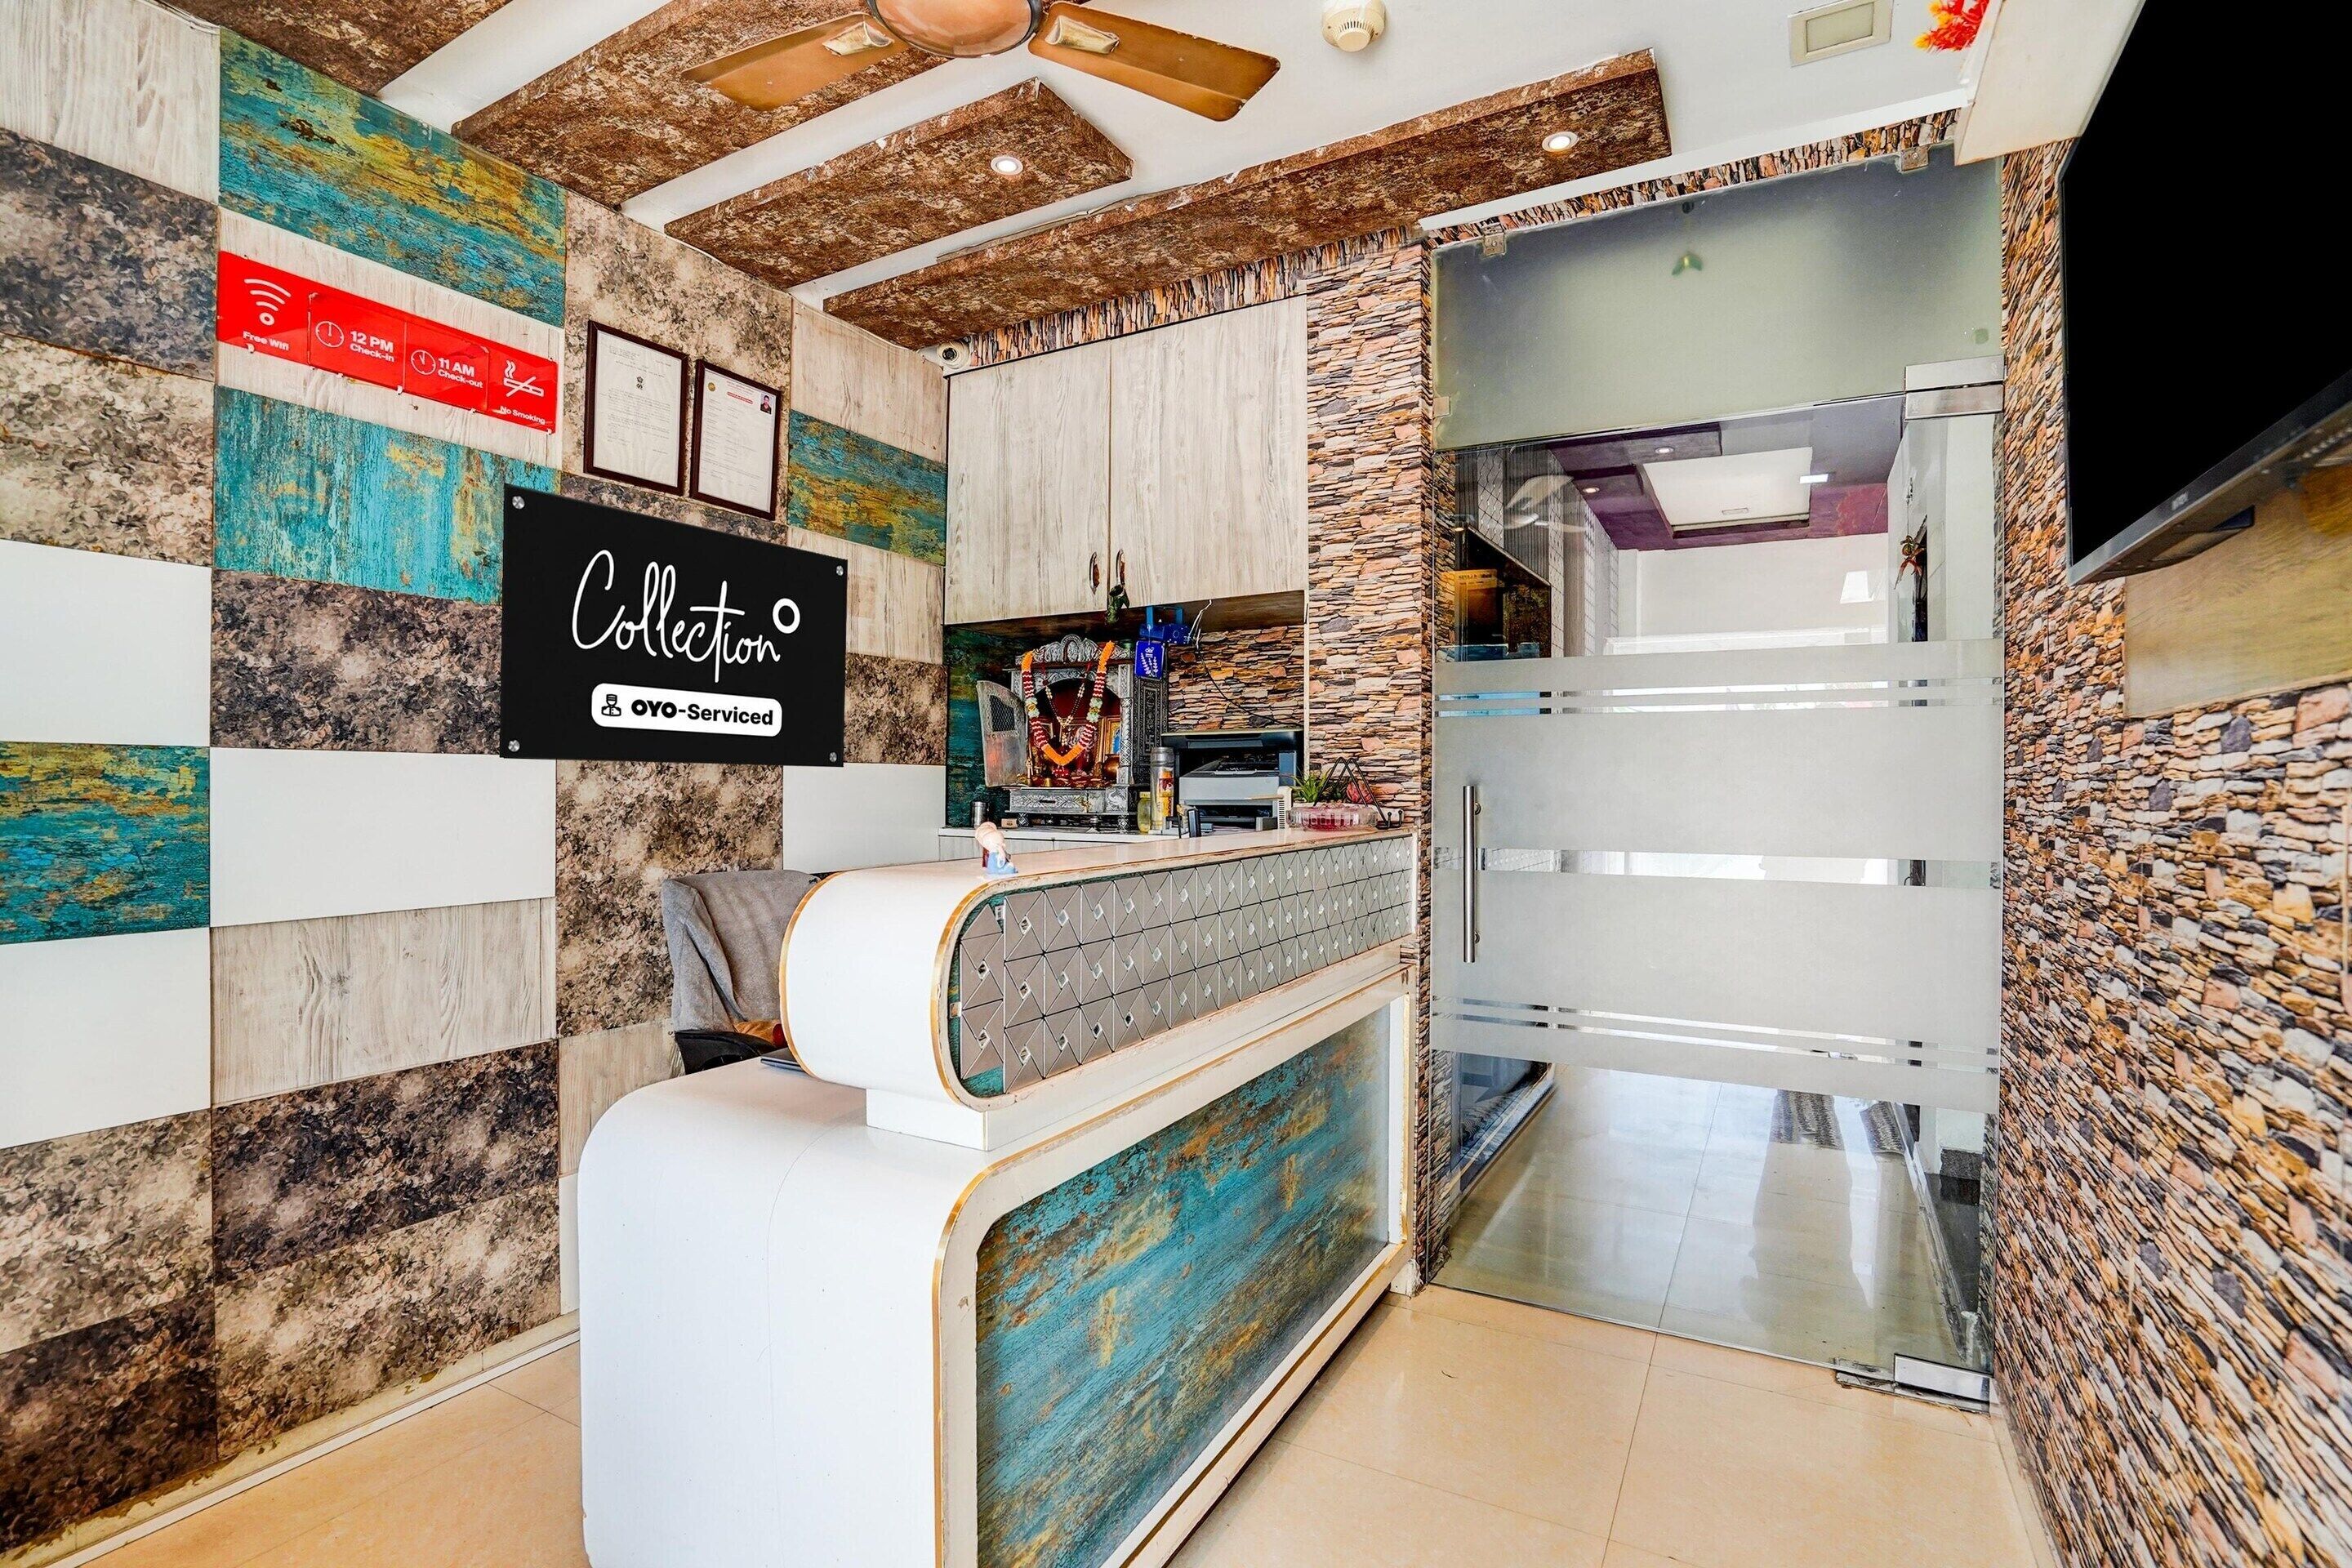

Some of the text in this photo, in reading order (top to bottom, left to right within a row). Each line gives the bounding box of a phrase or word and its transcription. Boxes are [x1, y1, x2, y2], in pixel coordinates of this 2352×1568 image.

[243, 331, 289, 351] Free Wifi
[350, 330, 394, 353] 12 PM
[350, 343, 394, 363] Check-in
[438, 357, 475, 377] 11 AM
[438, 369, 483, 389] Check-out
[500, 405, 546, 425] No Smoking
[572, 550, 781, 683] Collection
[630, 698, 774, 726] OYO-Serviced
